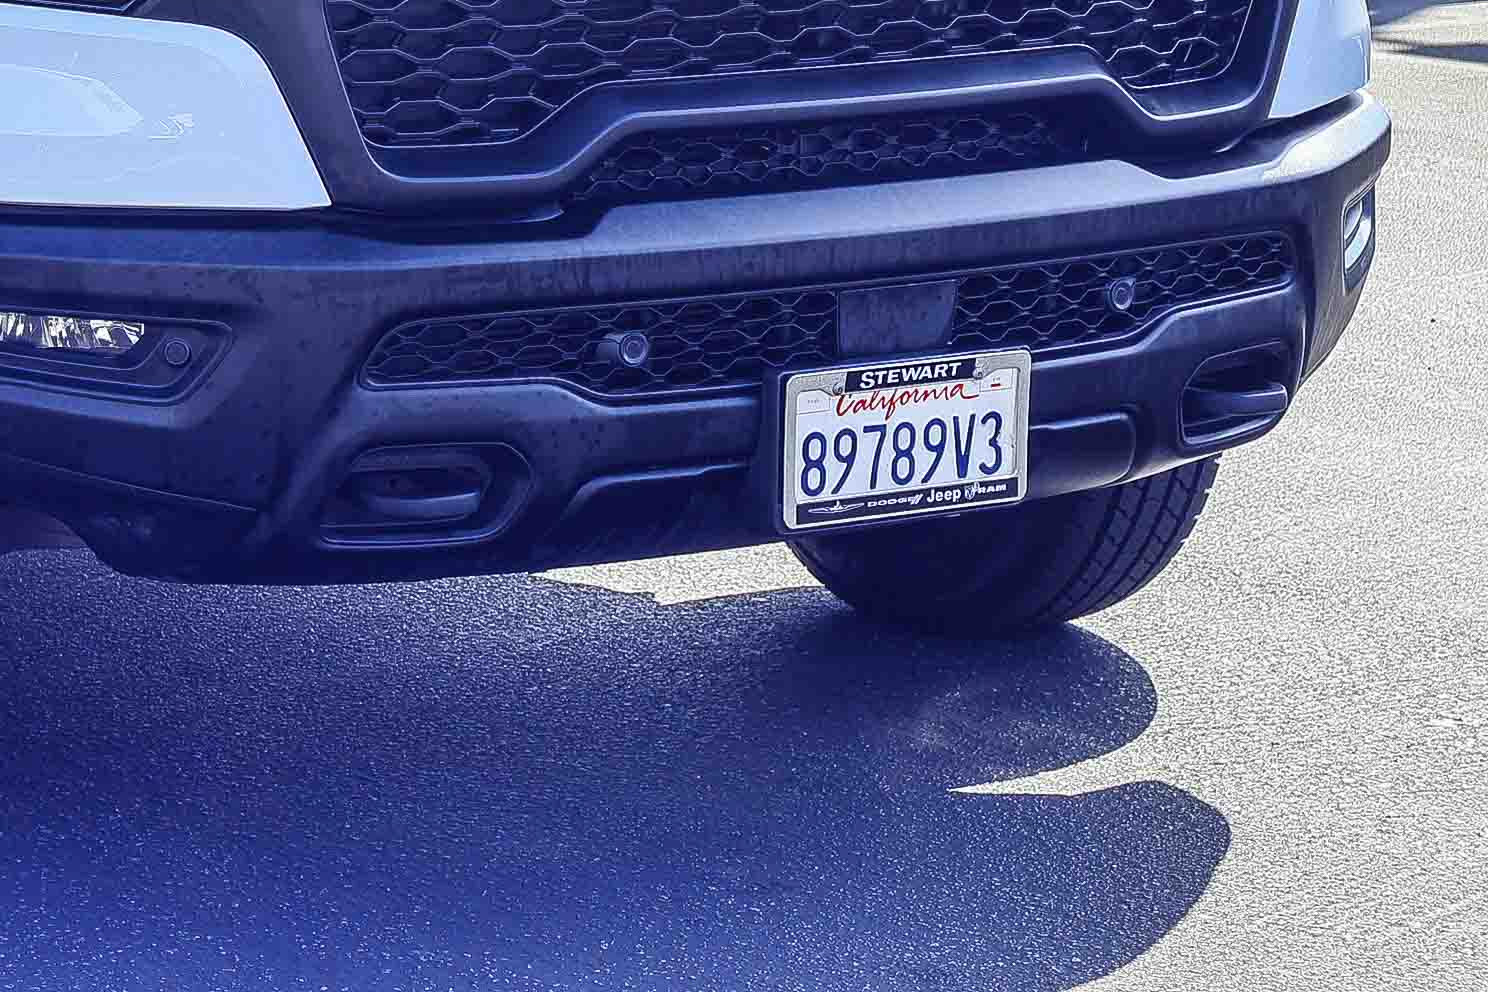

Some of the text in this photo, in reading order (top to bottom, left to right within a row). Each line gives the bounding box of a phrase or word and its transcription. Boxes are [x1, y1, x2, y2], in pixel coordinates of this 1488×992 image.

[859, 361, 962, 389] STEWART
[836, 383, 979, 421] California
[800, 410, 1003, 497] 89789V3
[926, 488, 962, 504] Jeep
[977, 483, 1007, 495] RAM
